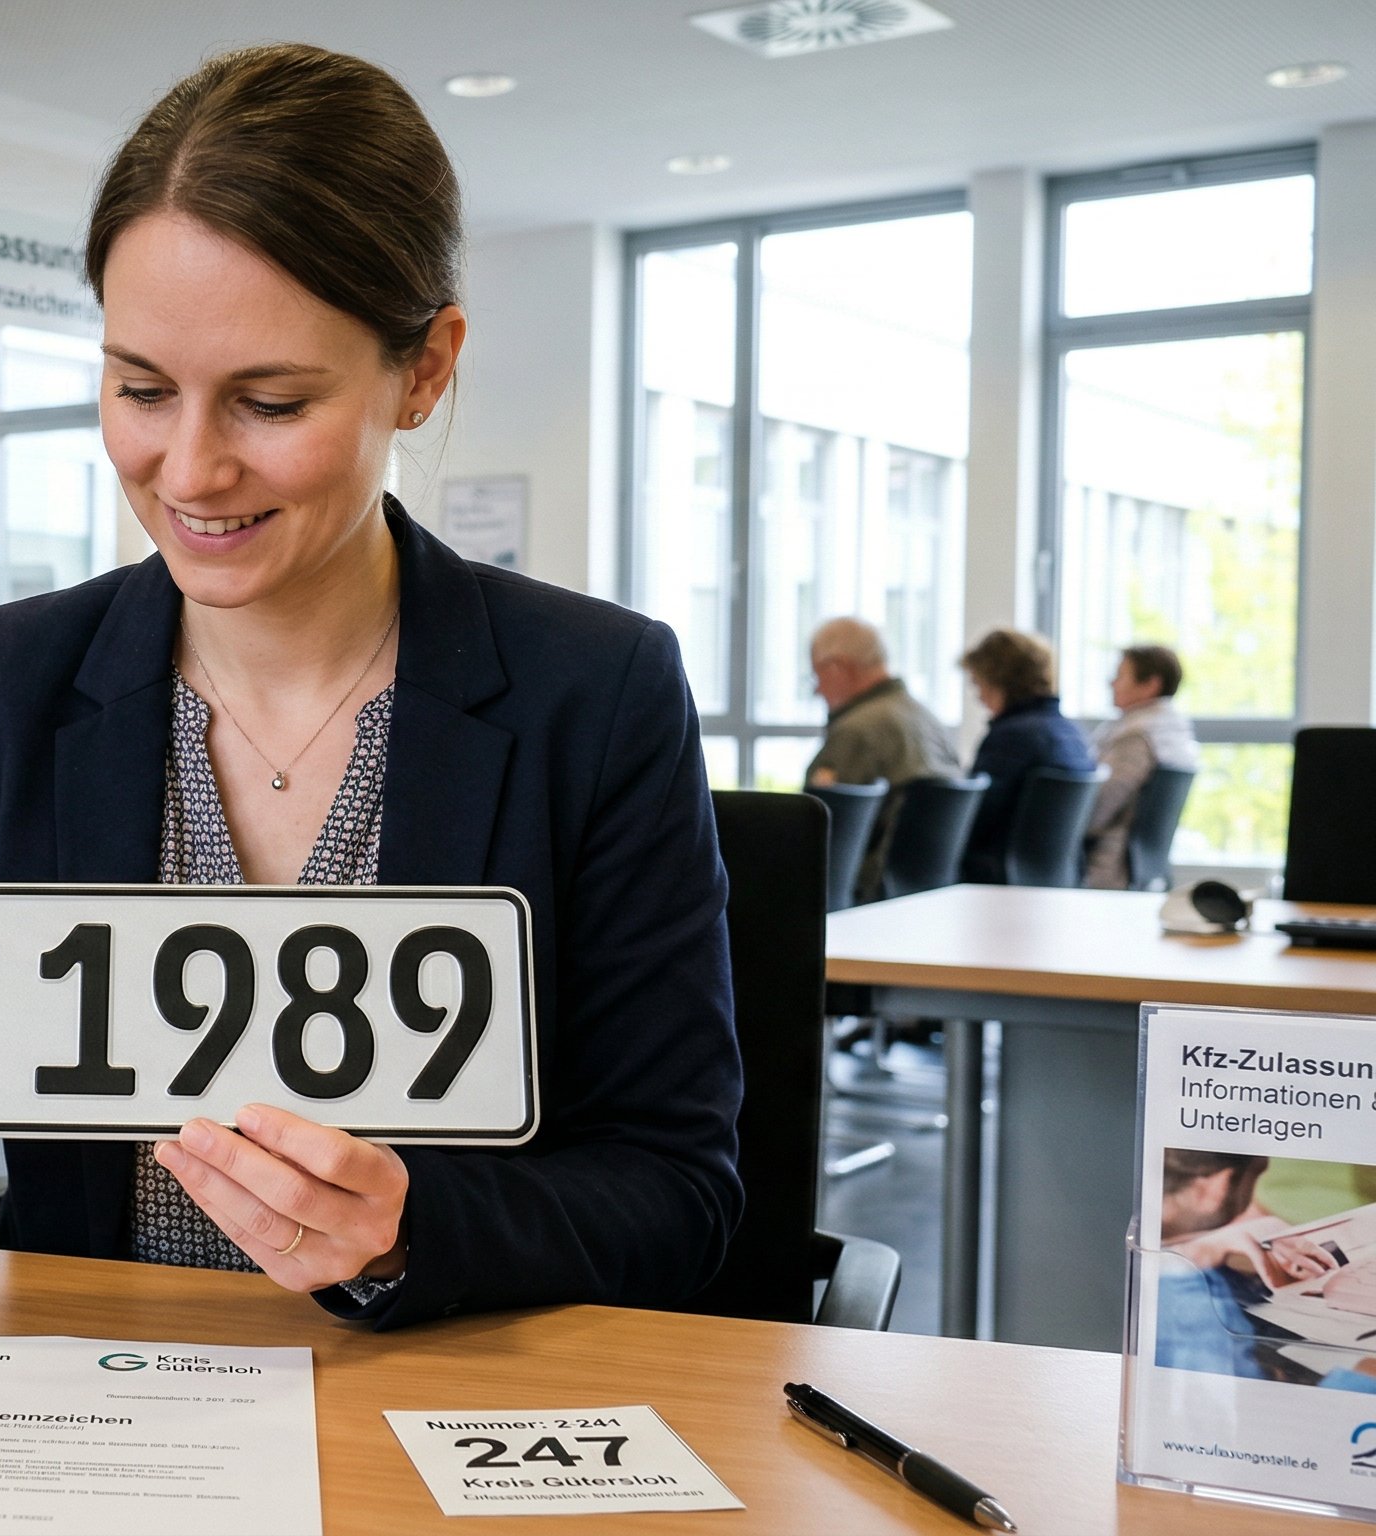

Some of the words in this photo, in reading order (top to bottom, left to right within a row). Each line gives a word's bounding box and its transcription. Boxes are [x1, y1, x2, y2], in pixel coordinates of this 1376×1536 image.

[35, 922, 492, 1099] 1989
[1181, 1076, 1361, 1111] Informationen
[1180, 1107, 1323, 1142] Unterlagen
[156, 1363, 263, 1375] Gütersloh
[157, 1354, 211, 1365] Kreis
[425, 1419, 547, 1431] Nummer:
[453, 1436, 630, 1468] 247
[462, 1477, 535, 1489] Kreis
[542, 1475, 678, 1488] Gütersloh
